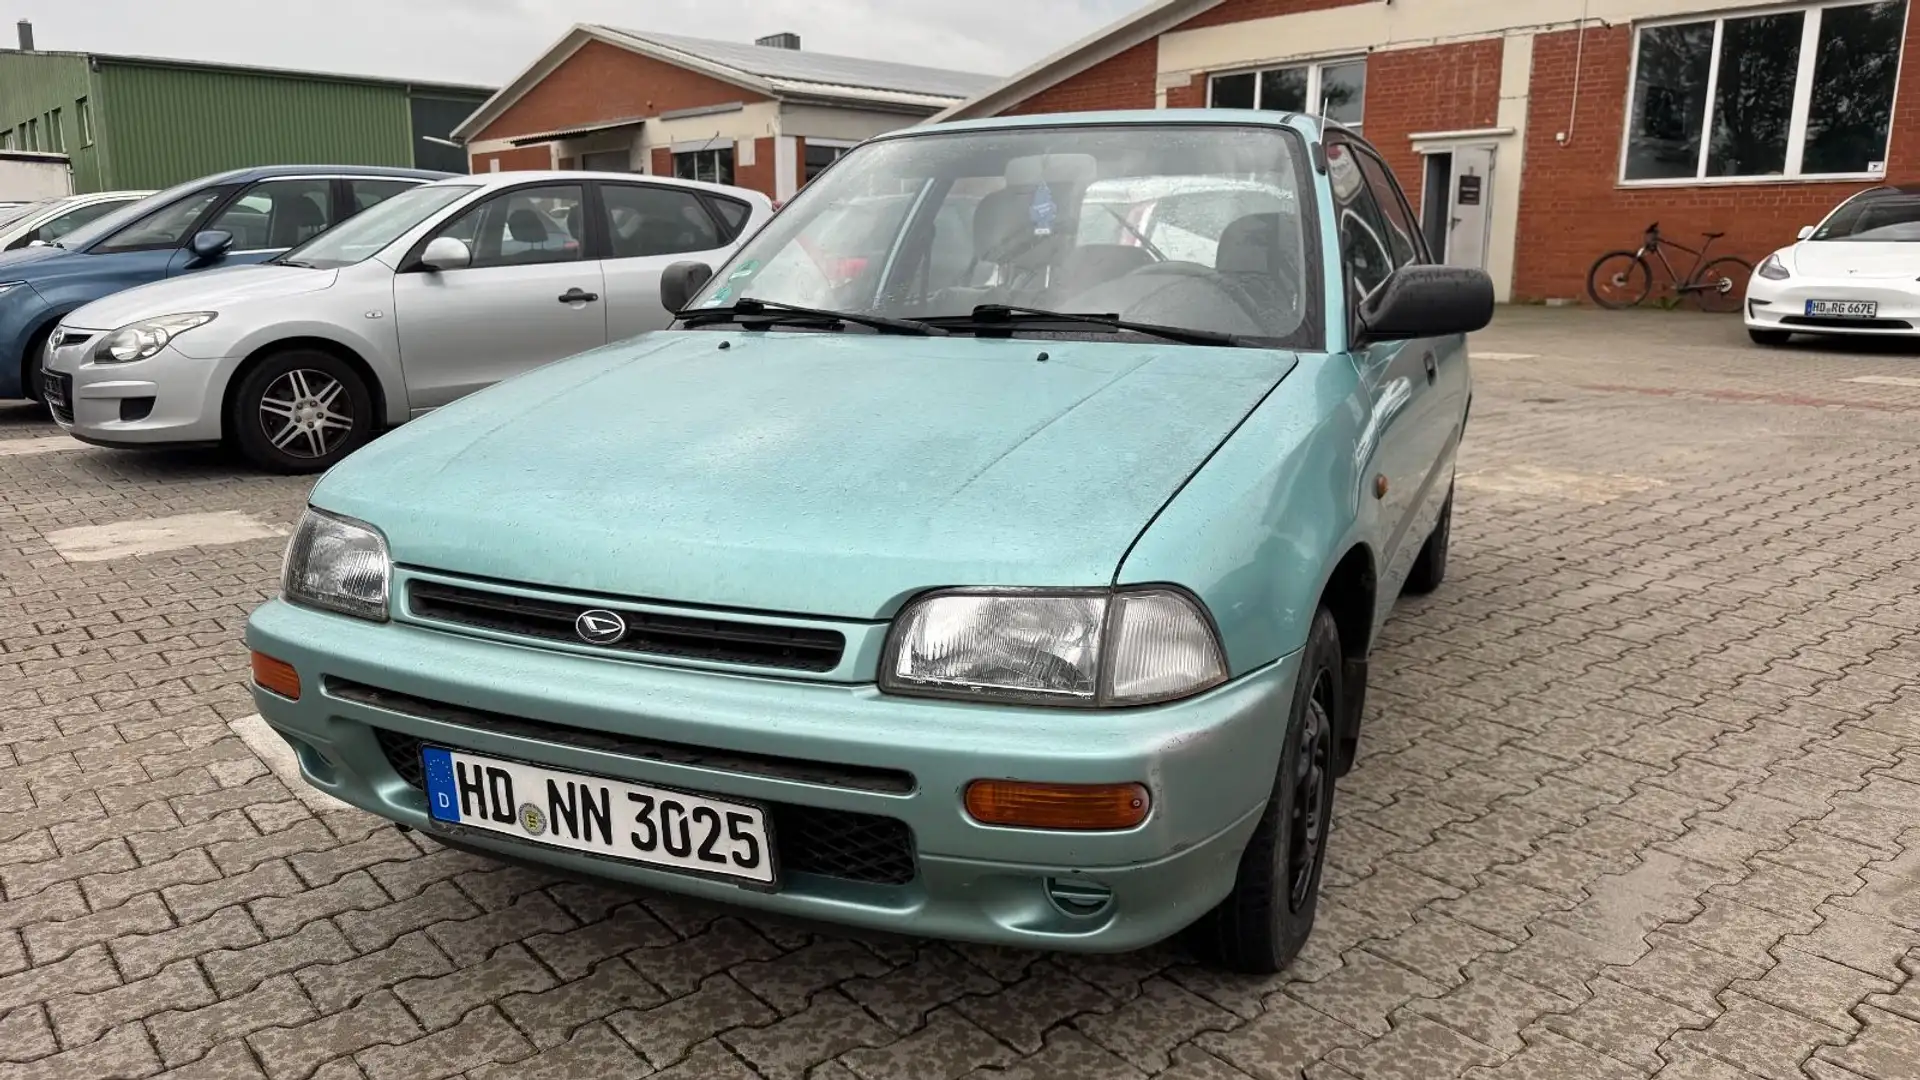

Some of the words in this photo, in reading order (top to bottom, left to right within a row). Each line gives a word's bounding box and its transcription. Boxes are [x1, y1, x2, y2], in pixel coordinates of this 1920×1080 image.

[1813, 303, 1826, 312] HD
[1831, 303, 1845, 313] RG
[1847, 303, 1874, 314] 667E
[438, 792, 449, 808] D
[456, 761, 517, 825] HD
[547, 778, 613, 846] NN
[627, 792, 760, 869] 3025
